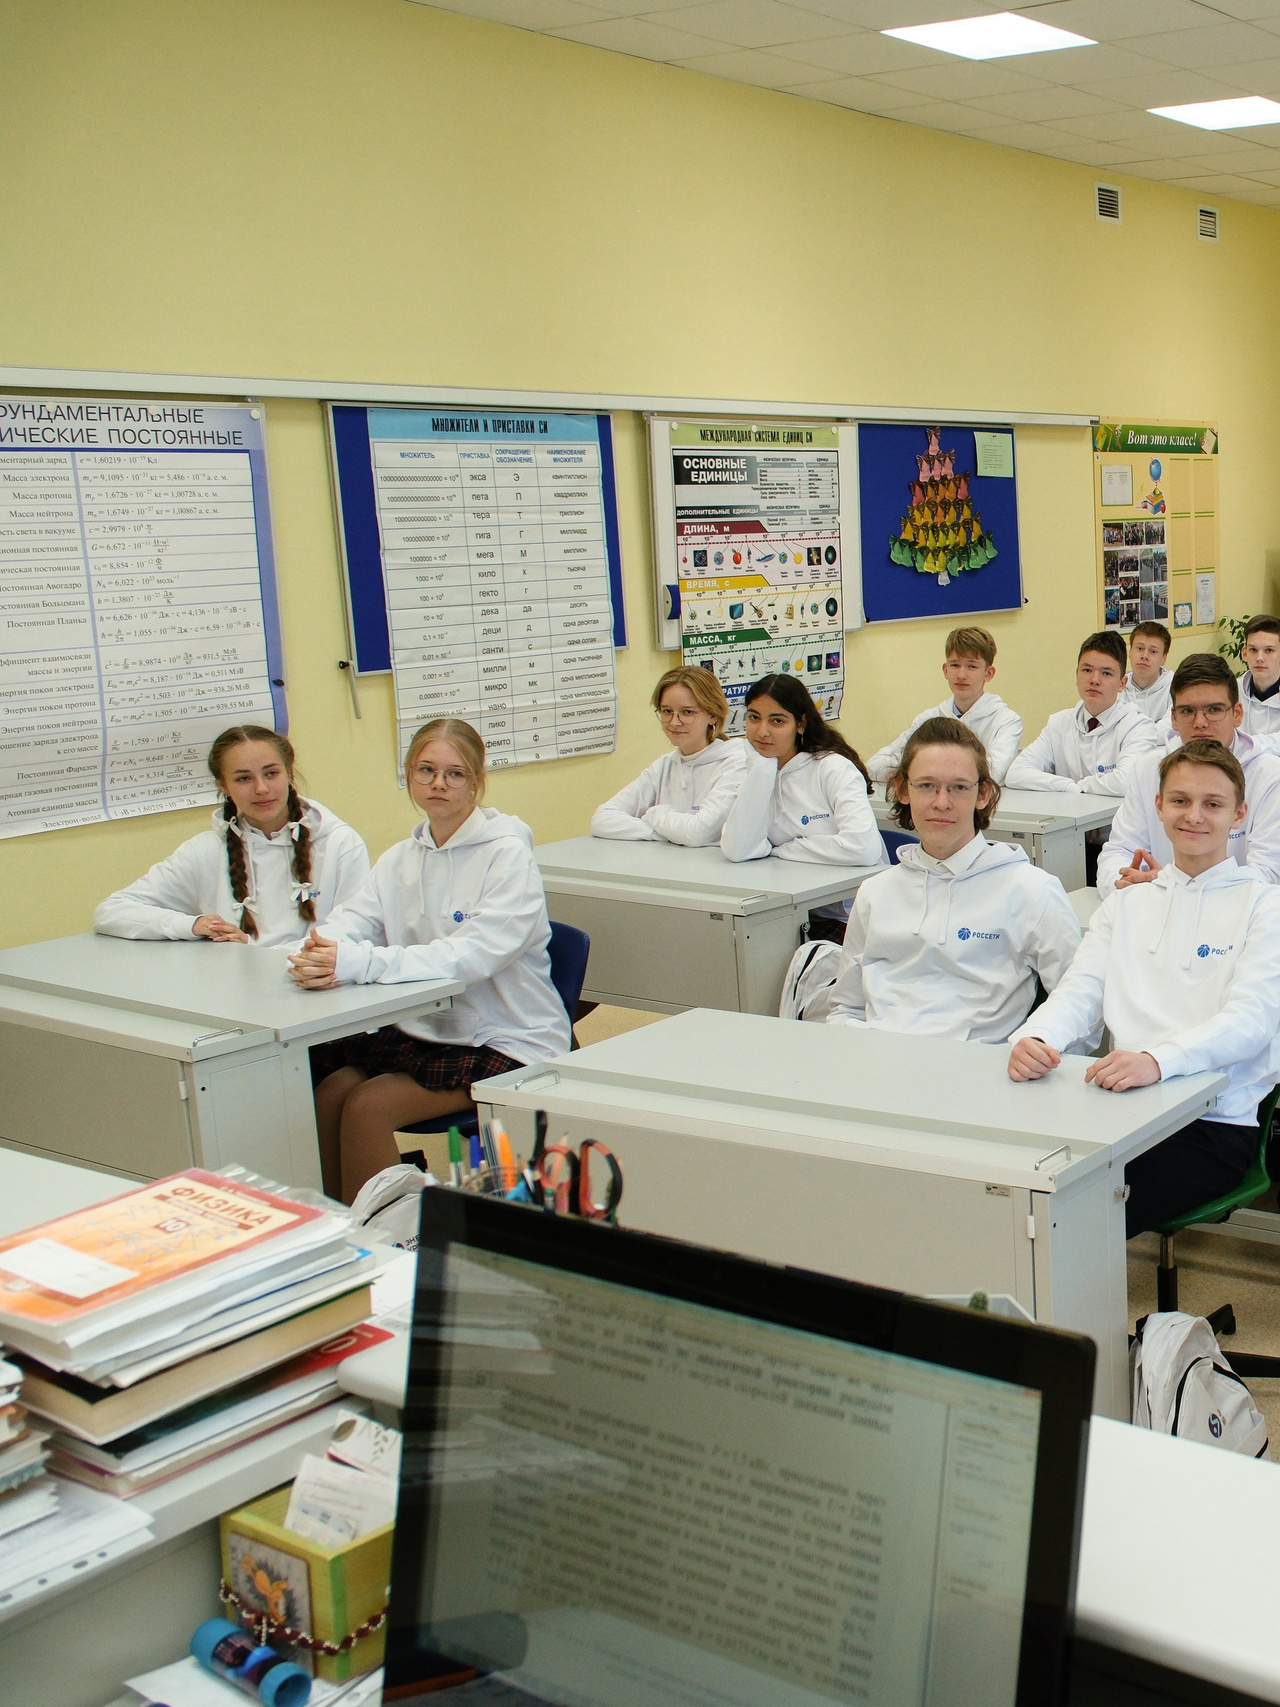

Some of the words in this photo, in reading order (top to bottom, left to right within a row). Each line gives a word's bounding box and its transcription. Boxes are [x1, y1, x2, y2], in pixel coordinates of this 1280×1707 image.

[431, 417, 480, 433] МНОЖИТЕЛИ
[483, 418, 489, 433] И
[492, 418, 536, 434] ПРИСТАВКИ
[539, 419, 549, 434] СИ
[108, 428, 244, 446] ПОСТОЯННЫЕ
[700, 429, 752, 443] МЕЖДУНАРОДНАЯ
[754, 430, 780, 443] СИСТЕМА
[782, 431, 804, 444] ЕДИНИЦ
[805, 431, 813, 443] СИ
[1127, 430, 1148, 445] Вот
[1150, 434, 1167, 446] это
[1169, 432, 1197, 447] класс!
[0, 456, 45, 467] ментарный
[46, 458, 67, 467] заряд
[496, 456, 534, 464] ОБОЗНАЧЕНИЕ
[682, 457, 747, 470] ОСНОВНЫЕ
[3, 474, 28, 482] Масса
[30, 475, 70, 483] электрона
[513, 473, 520, 481] Э
[690, 470, 748, 484] ЕДИНИЦЫ
[12, 492, 38, 500] Масса
[39, 492, 72, 501] протона
[471, 493, 489, 501] пета
[515, 492, 522, 501] П
[9, 510, 35, 518] Масса
[36, 510, 74, 518] нейтрона
[472, 511, 491, 520] тера
[517, 511, 523, 520] Т
[676, 509, 731, 517] ДОПОЛНИТЕЛЬНЫЕ
[732, 507, 759, 516] ЕДИНИЦЫ
[44, 528, 76, 536] вакууме
[683, 524, 719, 535] ДЛИНА,
[475, 531, 491, 539] гига
[519, 530, 524, 539] Г
[32, 545, 79, 553] постоянная
[520, 549, 527, 558] М
[476, 551, 495, 559] мега
[34, 565, 81, 573] постоянная
[478, 570, 496, 578] кило
[45, 582, 82, 591] Авогадро
[686, 578, 720, 589] ВРЕМЯ,
[479, 589, 499, 598] гекто
[42, 600, 86, 608] Больцмана
[569, 601, 588, 609] десять
[480, 607, 499, 616] дека
[522, 605, 532, 613] да
[7, 619, 56, 629] Постоянная
[57, 617, 87, 626] Планка
[577, 619, 599, 627] десятая
[482, 627, 502, 636] деци
[526, 624, 532, 632] д
[689, 635, 723, 646] МАССА,
[727, 634, 737, 642] кг
[482, 645, 504, 655] санти
[42, 654, 91, 663] взаимосвязи
[577, 654, 603, 662] тысячная
[27, 669, 53, 677] массы
[61, 665, 93, 674] энергии
[482, 665, 507, 674] милли
[560, 675, 575, 683] одна
[575, 671, 608, 680] миллионная
[29, 687, 54, 695] покоя
[55, 683, 95, 692] электрона
[484, 682, 508, 692] микро
[574, 688, 610, 699] миллиардная
[3, 705, 38, 715] Энергия
[39, 704, 64, 712] покоя
[65, 700, 96, 710] протона
[488, 702, 507, 711] нано
[576, 706, 610, 716] триллионная
[1, 725, 36, 734] Энергия
[37, 722, 61, 730] покоя
[62, 718, 98, 728] нейтрона
[488, 720, 507, 729] пико
[572, 723, 615, 735] квадриллионная
[33, 738, 59, 747] заряда
[60, 734, 99, 744] электрона
[532, 734, 540, 743] ф
[77, 744, 99, 752] массе
[485, 738, 511, 749] фемто
[559, 747, 573, 755] одна
[491, 758, 509, 766] атто
[17, 768, 65, 780] Постоянная
[66, 764, 98, 774] Фарадея
[24, 788, 53, 797] газовая
[54, 781, 98, 792] постоянная
[6, 807, 41, 818] Атомная
[41, 802, 74, 812] единица
[75, 798, 99, 807] массы
[809, 813, 830, 821] РОССЕТИ
[1228, 830, 1246, 840] ОССЕТИ
[972, 931, 1001, 940] РОССЕТИ
[1211, 944, 1234, 955] РОСИ
[171, 1186, 273, 1226] ФИЗИКА
